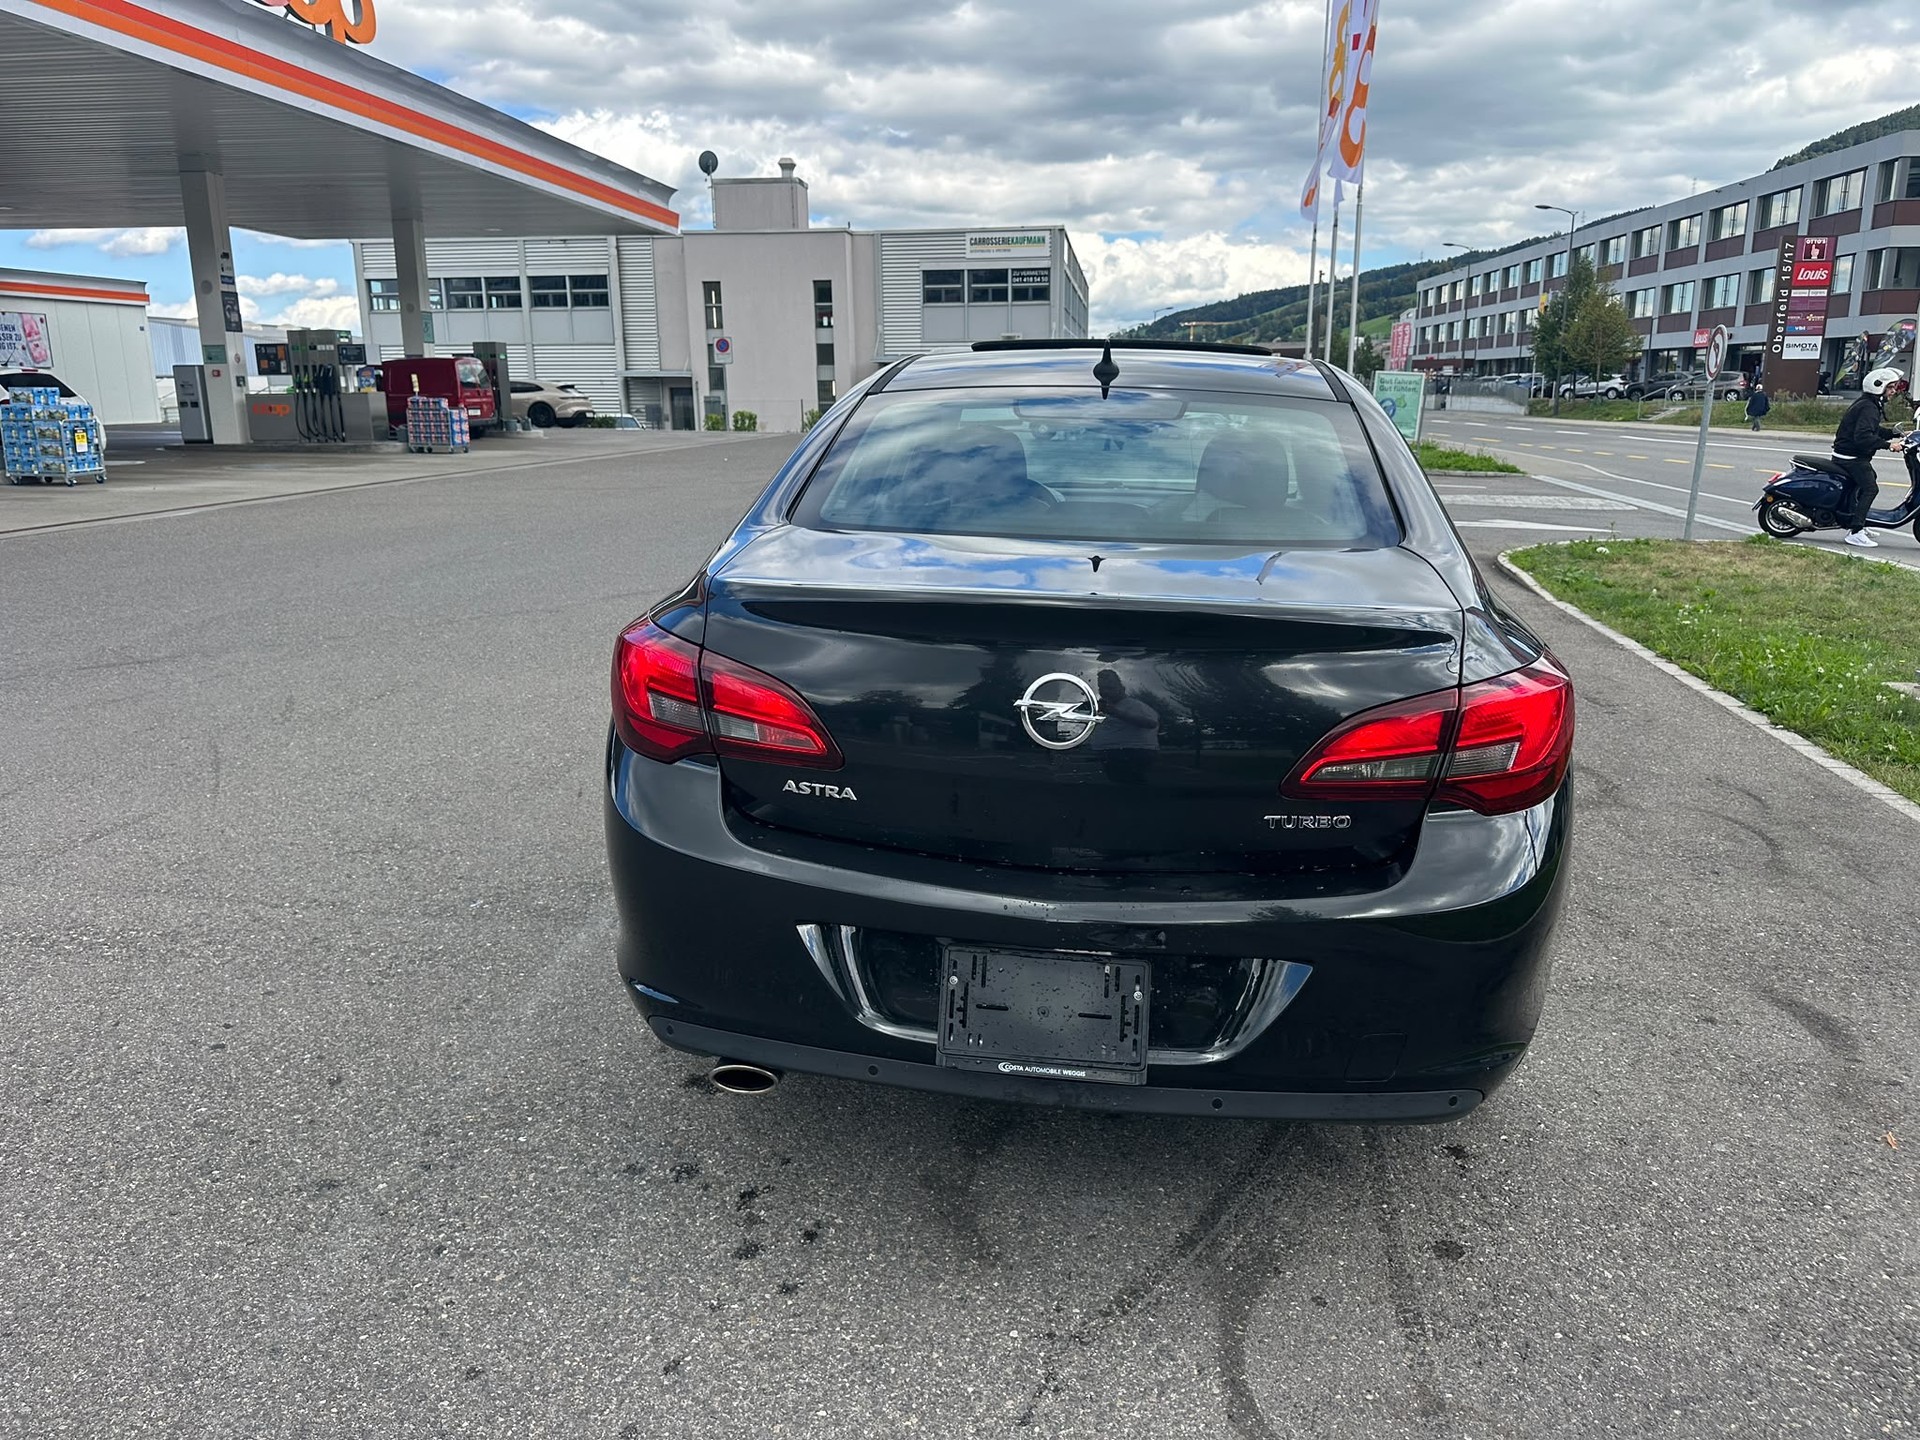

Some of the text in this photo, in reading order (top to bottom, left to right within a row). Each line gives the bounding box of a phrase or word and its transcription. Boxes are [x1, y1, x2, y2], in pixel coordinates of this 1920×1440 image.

[1797, 268, 1829, 280] Louis
[1772, 242, 1795, 353] Oberfeld 15/17
[0, 324, 16, 332] ENEN
[782, 780, 858, 800] ASTRA
[1264, 816, 1352, 828] TURBO
[1001, 1062, 1024, 1072] COSTA
[1024, 1066, 1061, 1074] AUTOMOBILE
